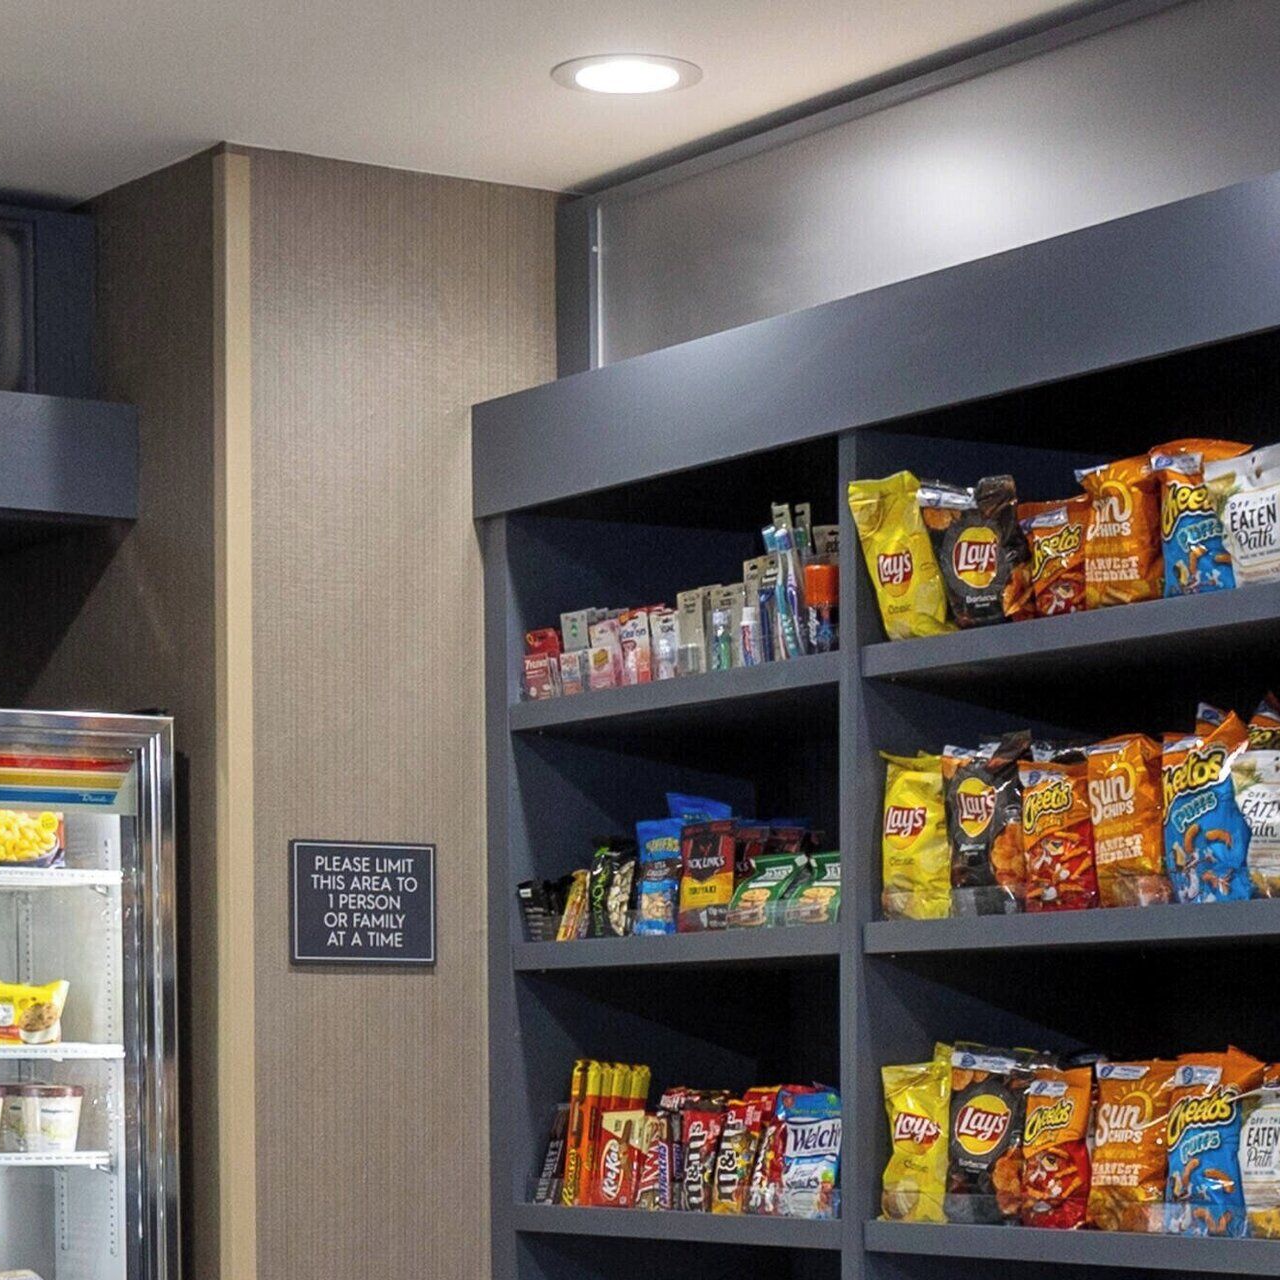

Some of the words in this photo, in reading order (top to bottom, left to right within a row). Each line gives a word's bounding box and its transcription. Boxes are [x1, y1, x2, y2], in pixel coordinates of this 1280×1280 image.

[1230, 505, 1277, 532] EATEN
[878, 549, 913, 584] Lay's
[957, 537, 998, 573] Lay's
[1162, 748, 1227, 826] heetos
[885, 805, 926, 838] Lay's
[957, 790, 996, 823] Lay's
[315, 855, 370, 873] PLEASE
[375, 857, 415, 874] LIMIT
[311, 874, 346, 891] THIS
[350, 875, 392, 892] AREA
[396, 876, 418, 893] TO
[328, 893, 334, 909] 1
[339, 894, 401, 911] PERSON
[324, 912, 348, 929] OR
[353, 912, 406, 930] FAMILY
[326, 931, 346, 947] AT
[351, 932, 363, 947] A
[368, 932, 404, 948] TIME
[790, 1123, 841, 1151] Welch'
[894, 1112, 943, 1147] Lay's
[958, 1106, 1009, 1142] Lay's
